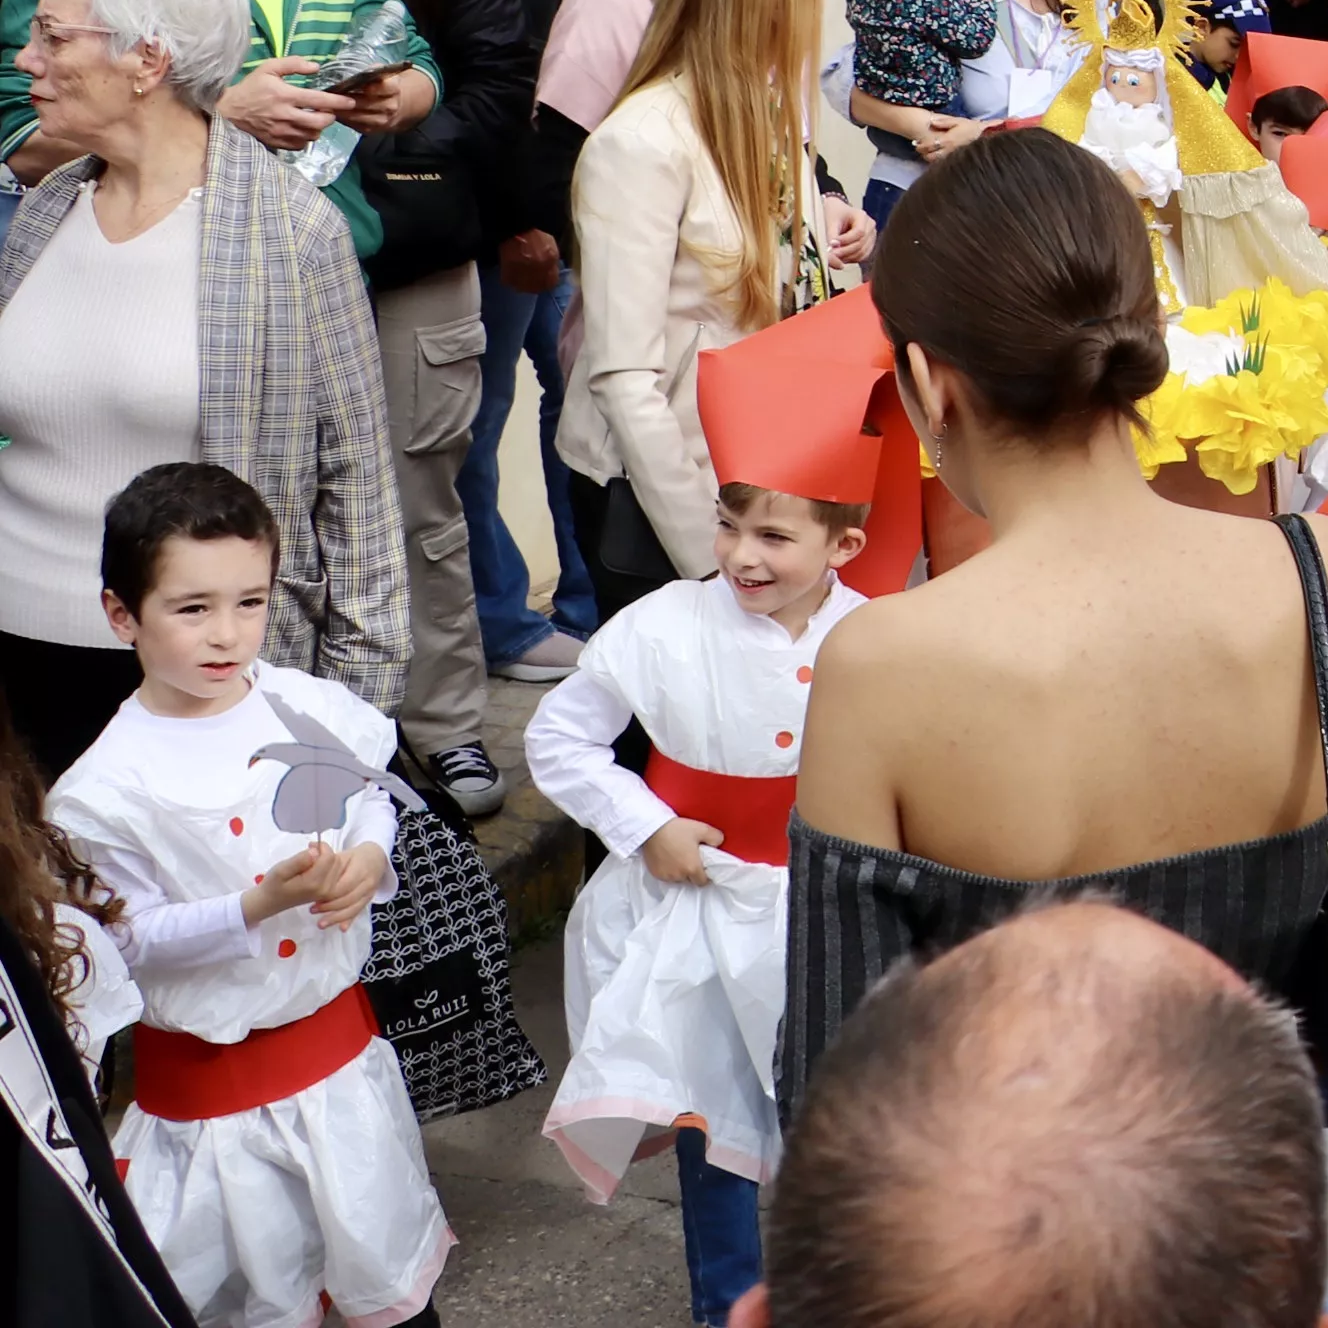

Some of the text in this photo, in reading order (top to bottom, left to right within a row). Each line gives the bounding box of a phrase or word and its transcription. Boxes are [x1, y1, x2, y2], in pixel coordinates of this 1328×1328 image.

[420, 172, 443, 181] LOLA
[386, 994, 469, 1036] LOLA RUIZ
